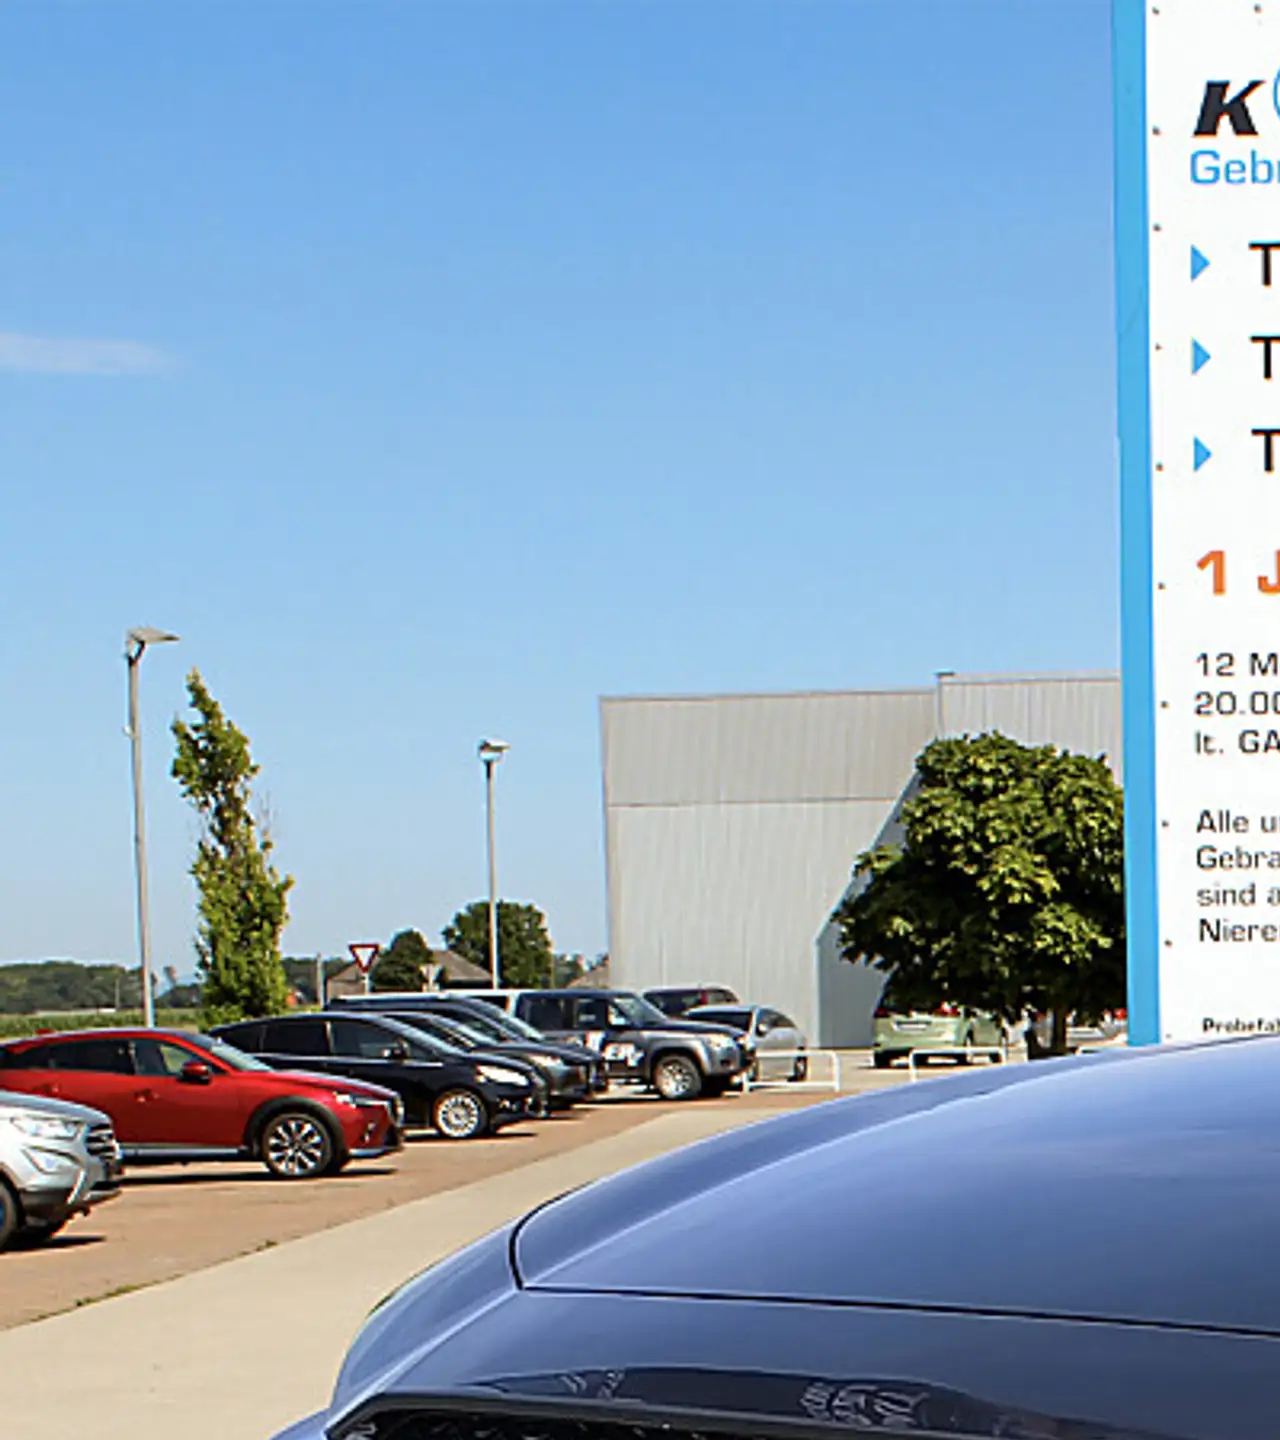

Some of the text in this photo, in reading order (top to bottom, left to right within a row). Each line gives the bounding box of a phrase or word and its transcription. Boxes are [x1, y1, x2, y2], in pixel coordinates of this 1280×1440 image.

[1197, 551, 1226, 596] 1
[1197, 653, 1234, 677] 12
[1197, 810, 1249, 833] Alle
[1197, 883, 1255, 906] sind
